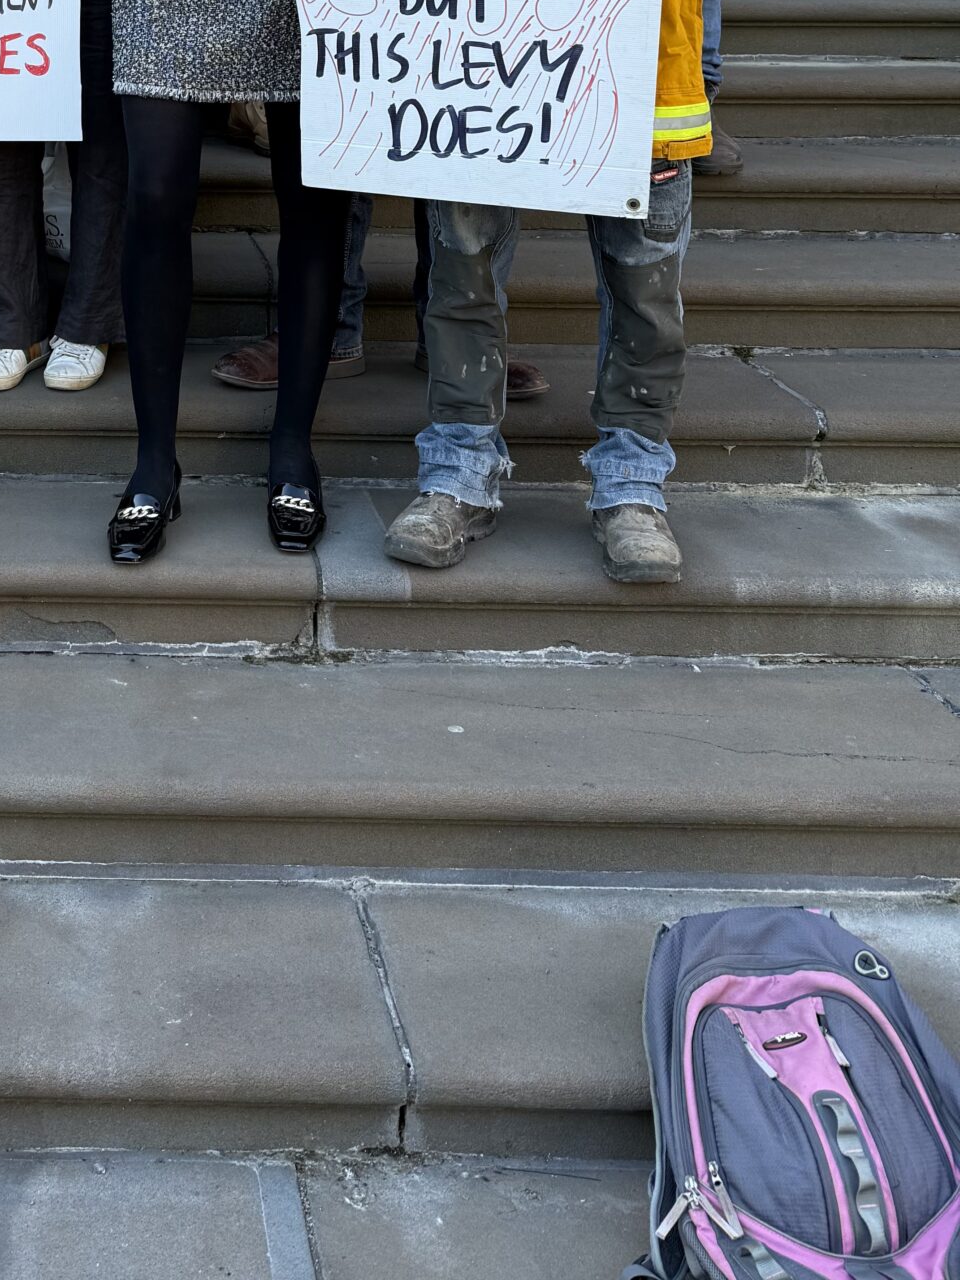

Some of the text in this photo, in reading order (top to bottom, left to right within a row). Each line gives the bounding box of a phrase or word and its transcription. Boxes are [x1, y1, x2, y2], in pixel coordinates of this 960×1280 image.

[307, 27, 584, 102] THIS LEVY
[387, 97, 553, 164] DOES!
